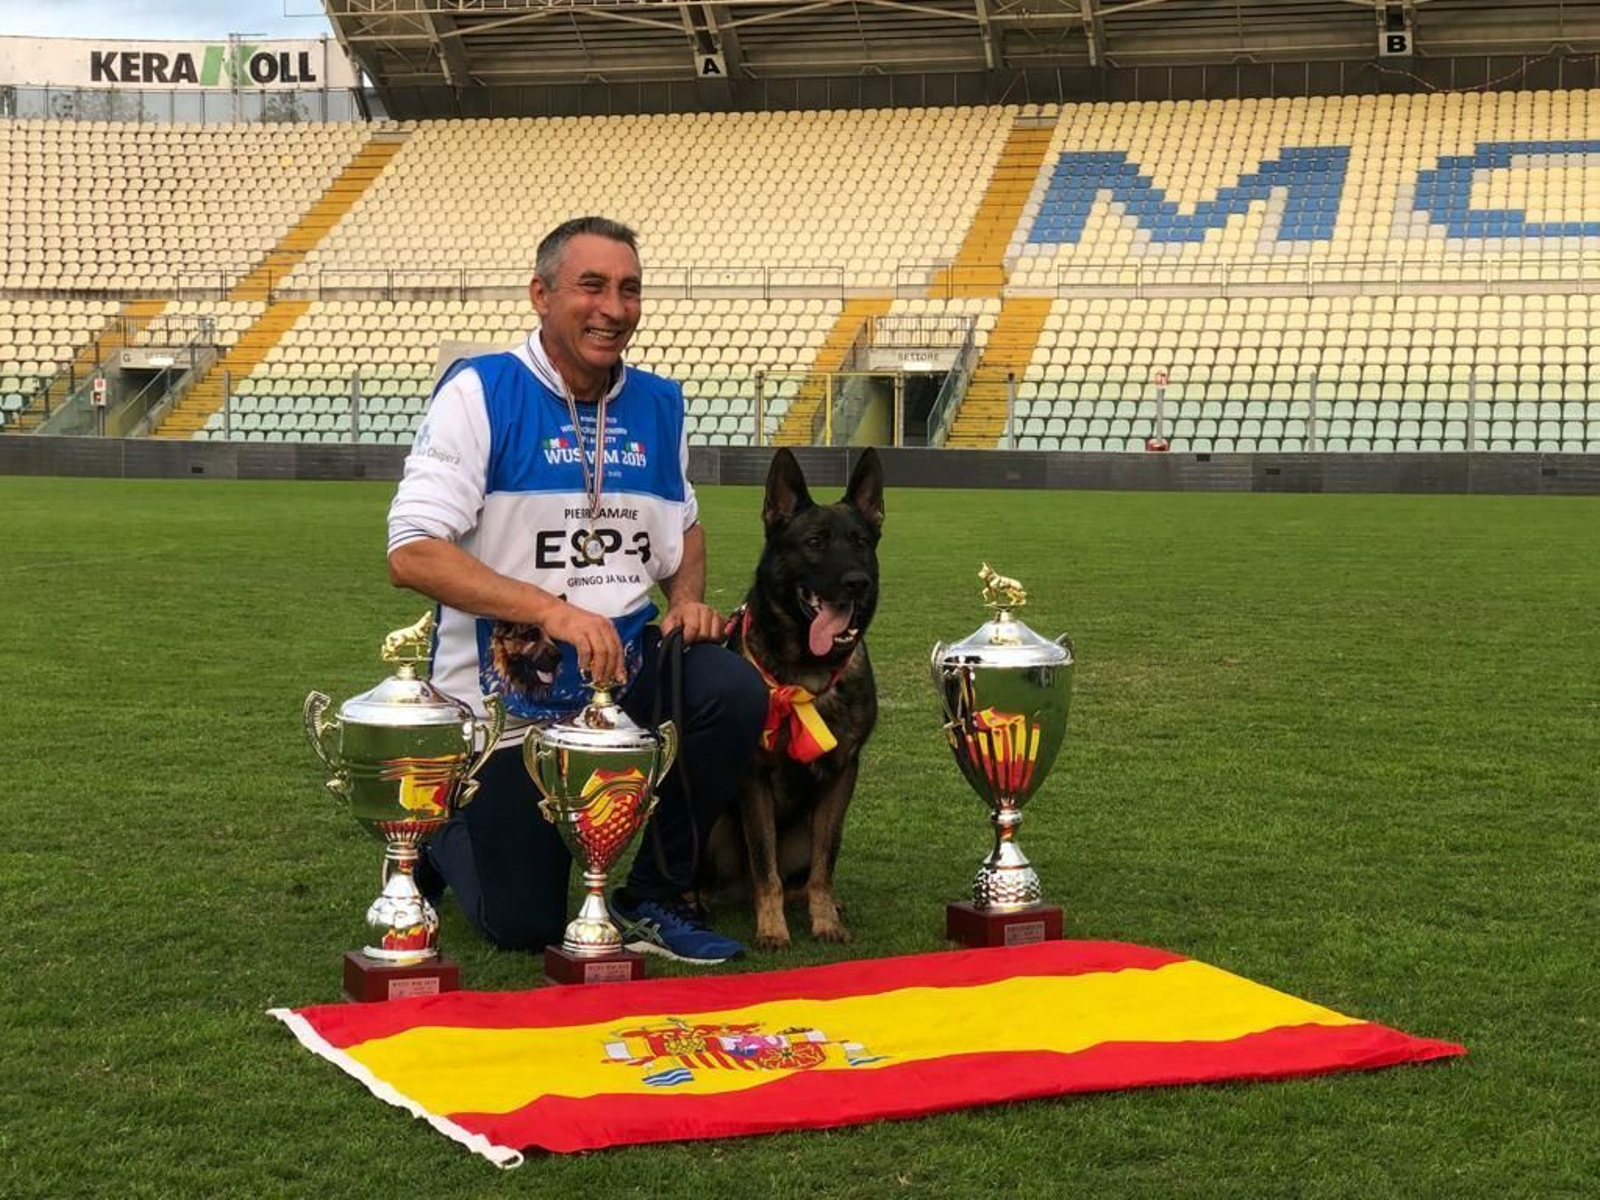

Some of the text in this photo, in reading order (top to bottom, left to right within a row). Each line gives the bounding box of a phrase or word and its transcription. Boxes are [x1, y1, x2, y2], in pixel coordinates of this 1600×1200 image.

[1387, 35, 1407, 53] B
[91, 45, 317, 86] KERAKOLL
[702, 57, 721, 75] A
[621, 451, 648, 468] 2019
[535, 528, 652, 570] ESP-3
[567, 575, 604, 588] GRINGO
